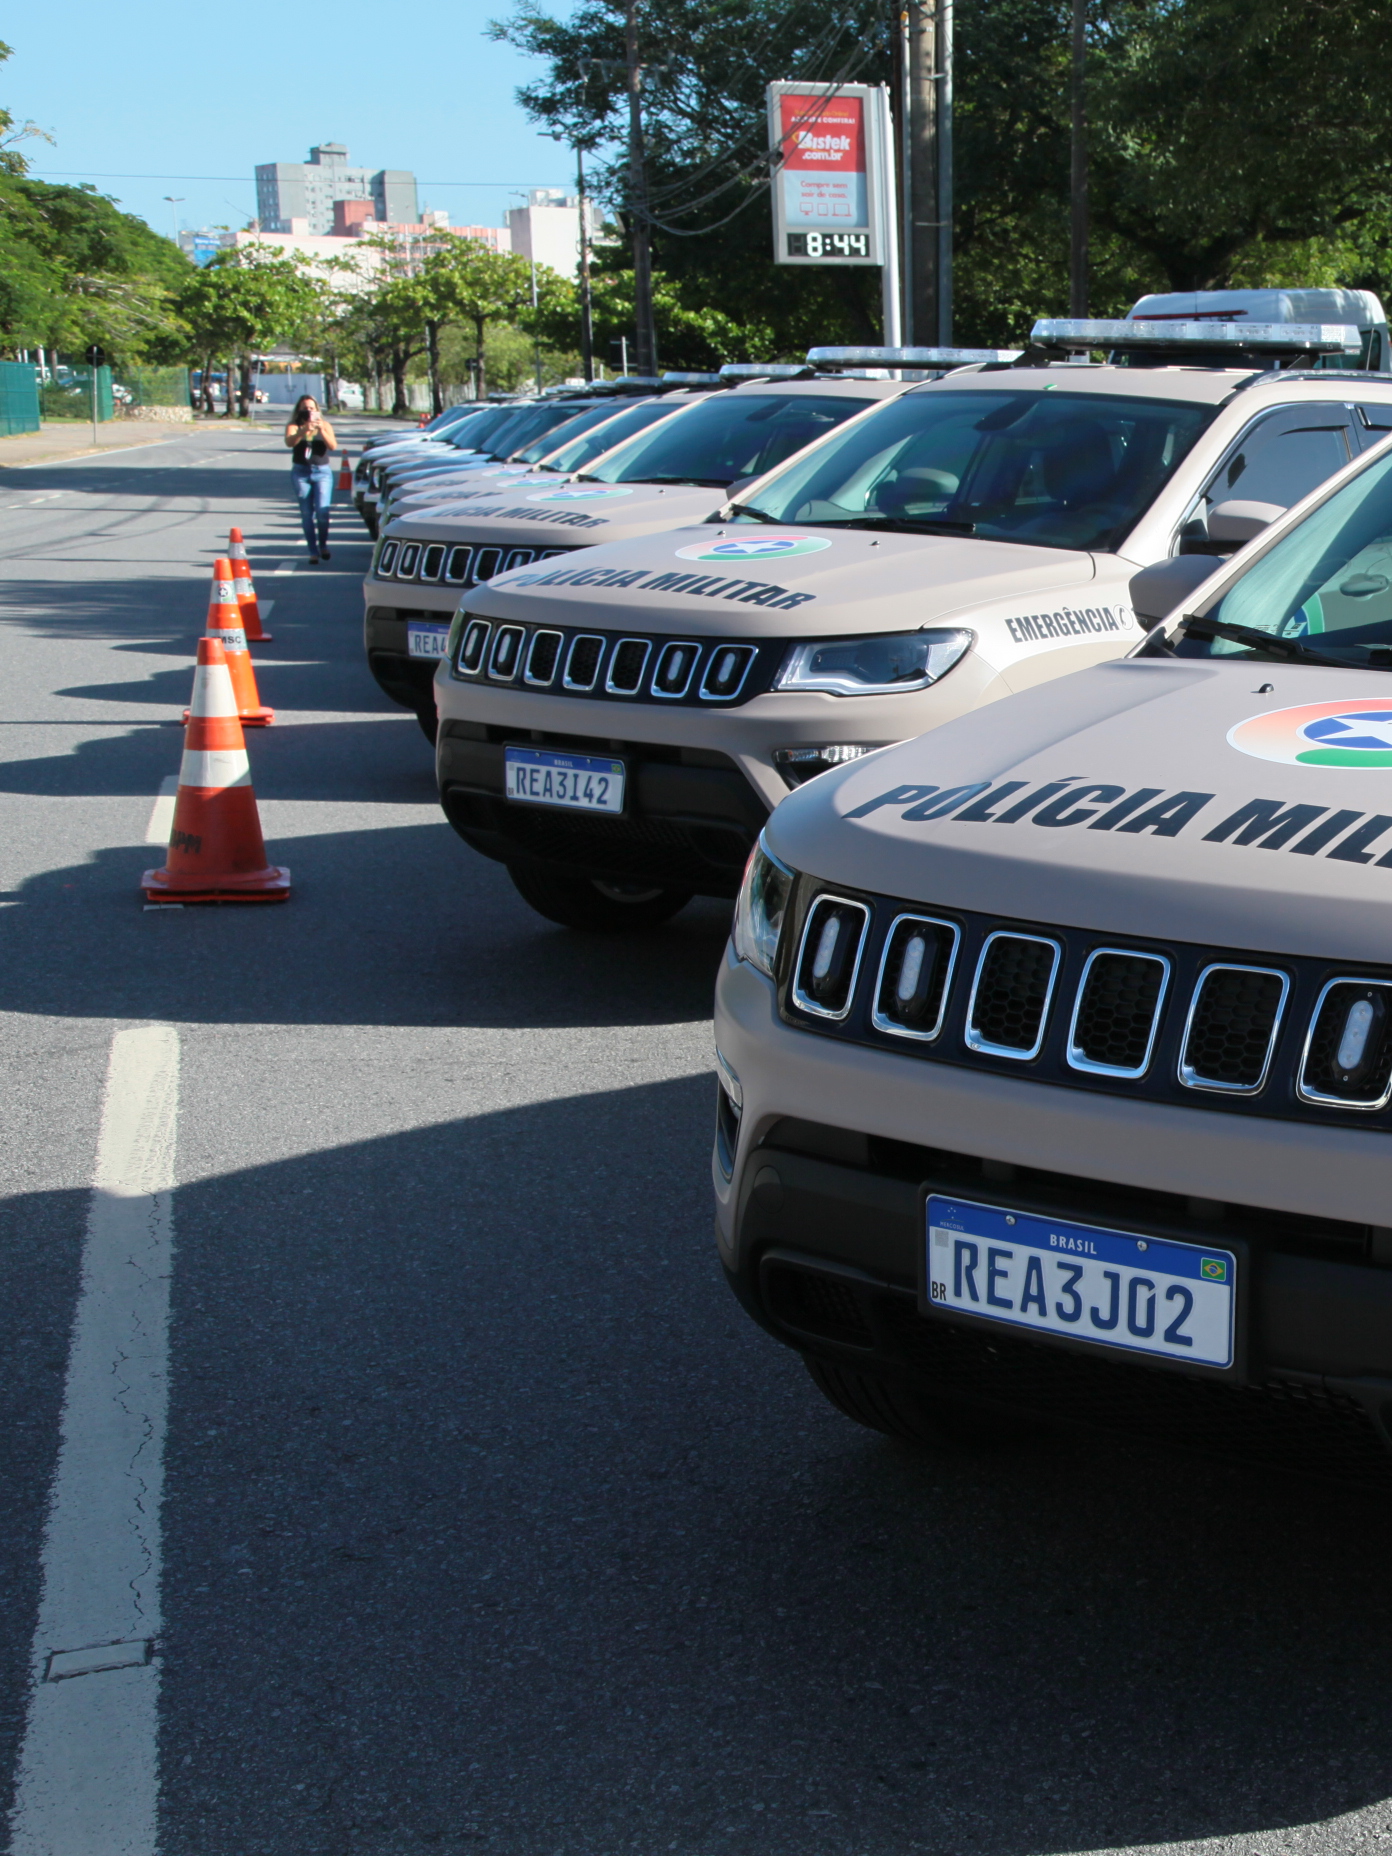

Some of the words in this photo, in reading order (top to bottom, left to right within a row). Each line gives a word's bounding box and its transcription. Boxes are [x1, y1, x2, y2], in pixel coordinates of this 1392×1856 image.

[797, 131, 851, 150] Bistek
[802, 149, 843, 160] .com.br
[800, 180, 830, 189] Compre
[806, 232, 866, 257] 8:44
[494, 507, 610, 528] MILITAR
[637, 572, 817, 610] MILITAR
[1005, 606, 1119, 643] EMERGÊNCIA
[516, 766, 610, 805] REA3I42
[841, 776, 1214, 838] POLÍCIA
[940, 1220, 965, 1231] MERCOSUL
[1050, 1233, 1097, 1255] BRASIL
[931, 1280, 946, 1302] BR
[953, 1239, 1193, 1347] REA3J02
